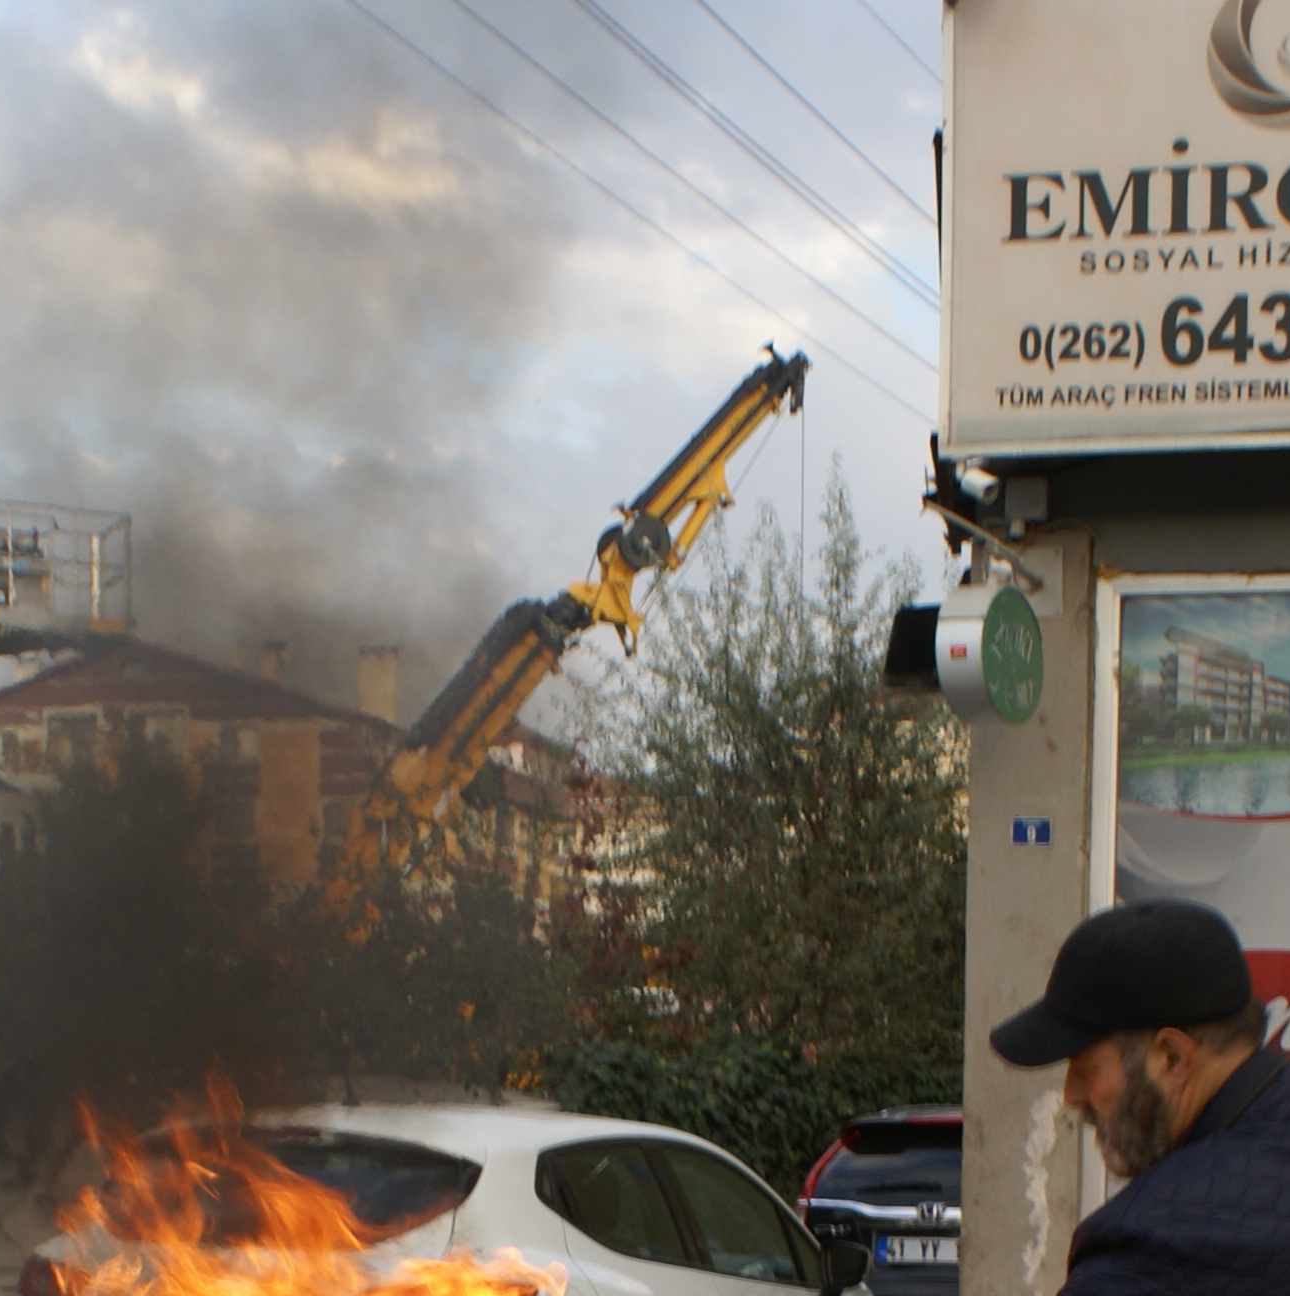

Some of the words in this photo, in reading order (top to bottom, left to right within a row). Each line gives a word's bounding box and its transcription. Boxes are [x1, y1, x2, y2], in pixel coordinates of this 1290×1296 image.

[1079, 245, 1225, 275] SOSYAL
[1018, 320, 1146, 373] 0(262)
[995, 382, 1044, 408] TÜM
[1050, 384, 1117, 411] ARAÇ
[1124, 382, 1187, 404] FREN
